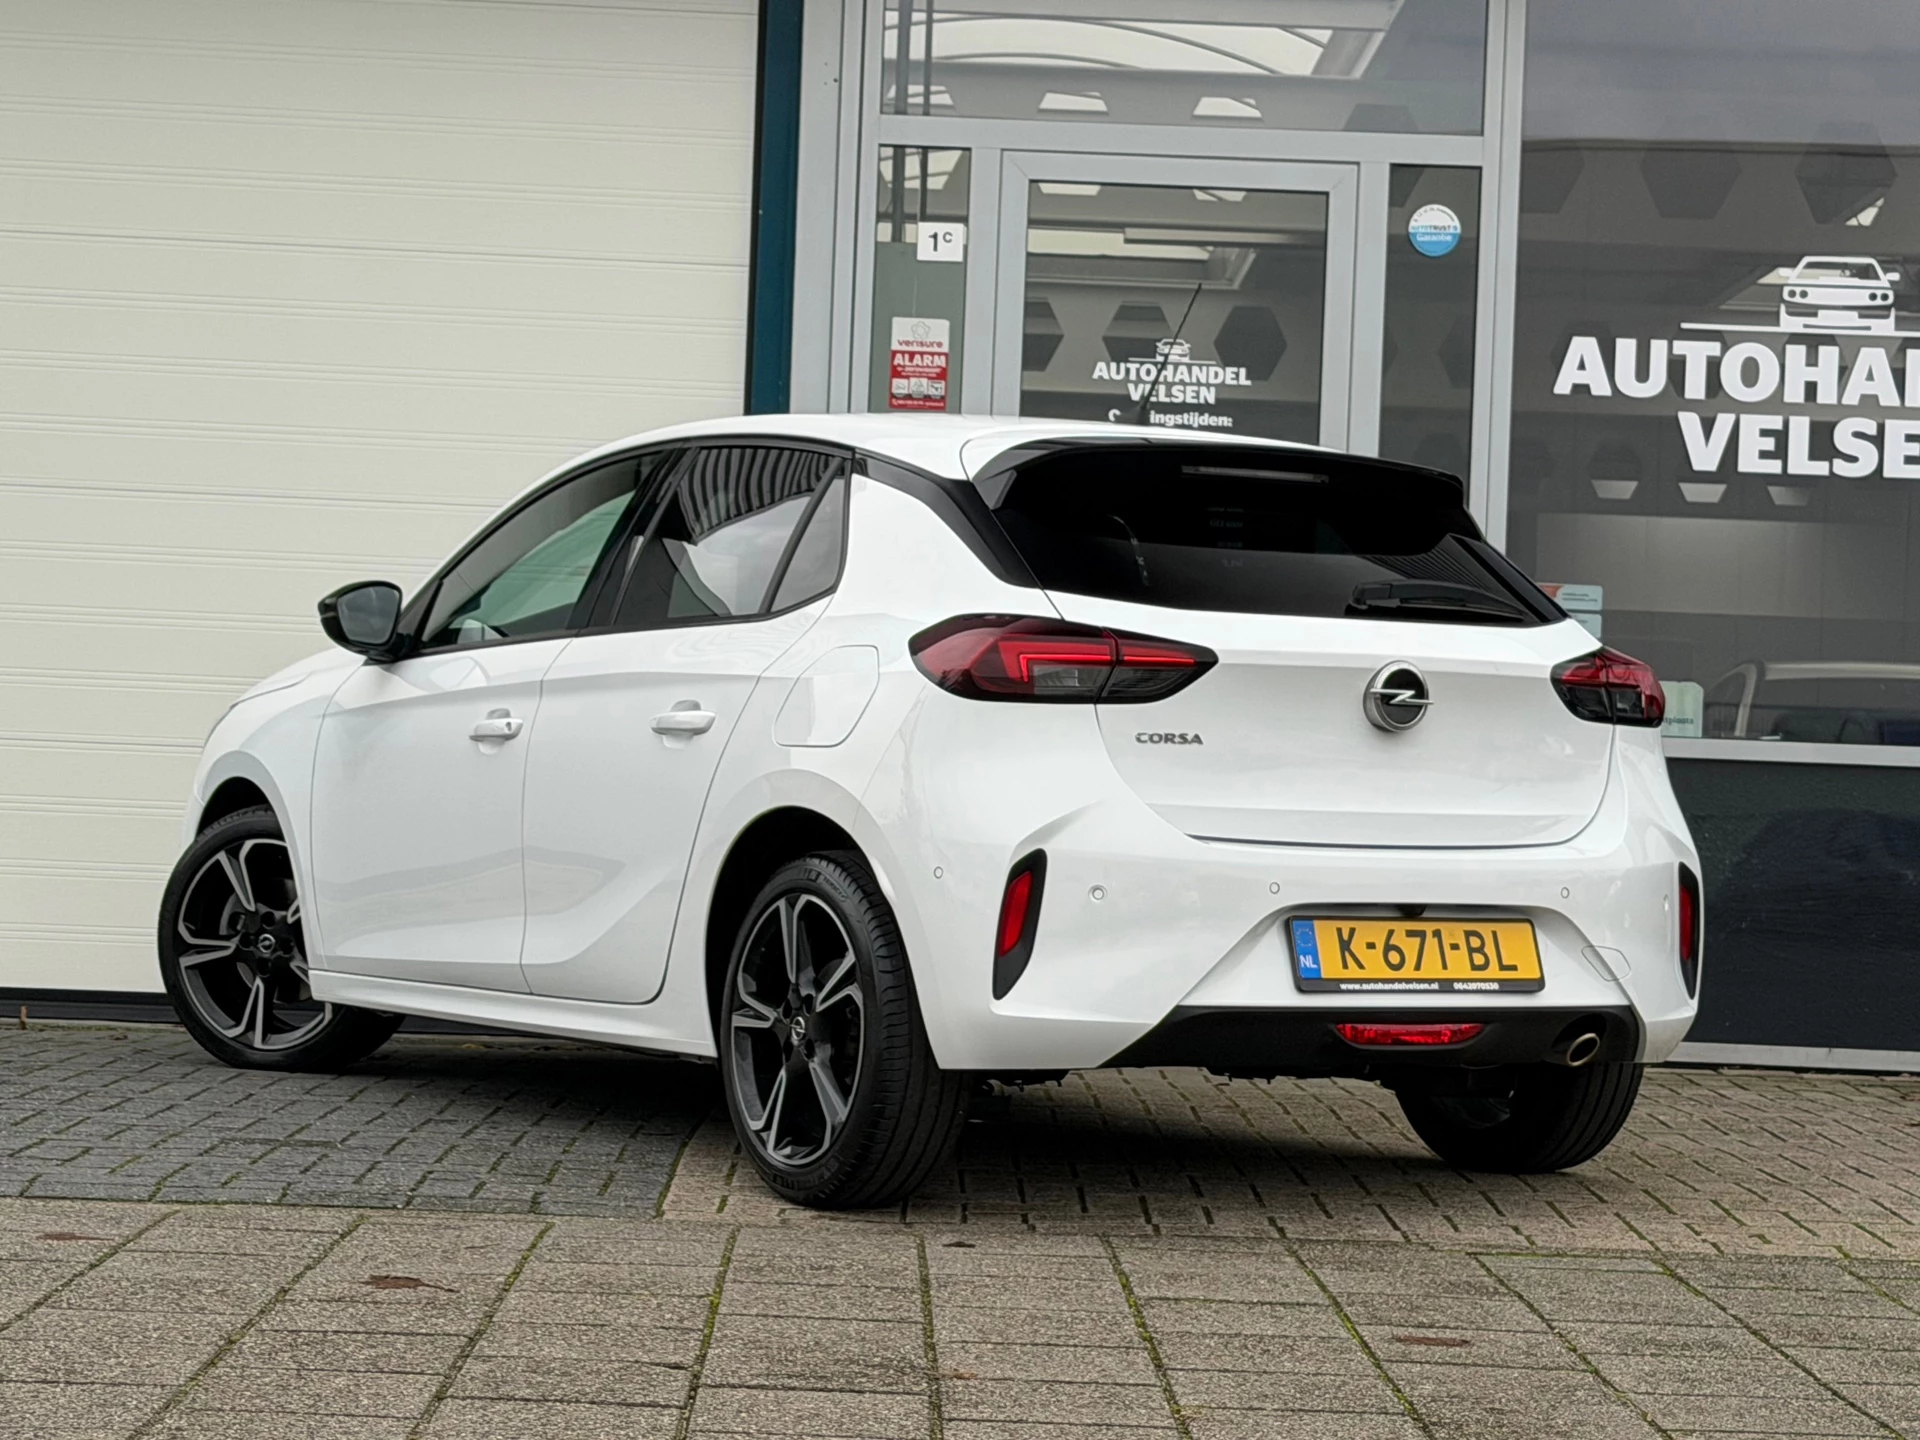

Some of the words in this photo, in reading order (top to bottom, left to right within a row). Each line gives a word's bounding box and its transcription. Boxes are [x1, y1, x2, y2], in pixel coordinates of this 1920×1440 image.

[893, 353, 946, 367] ALARM
[1092, 361, 1252, 386] AUTOHANDEL
[1553, 335, 1920, 408] AUTOHA
[1135, 732, 1204, 745] CORSA
[1336, 927, 1518, 971] K-671-BL
[1299, 954, 1318, 969] NL
[1339, 982, 1439, 990] www.autohandelvelsen.nl
